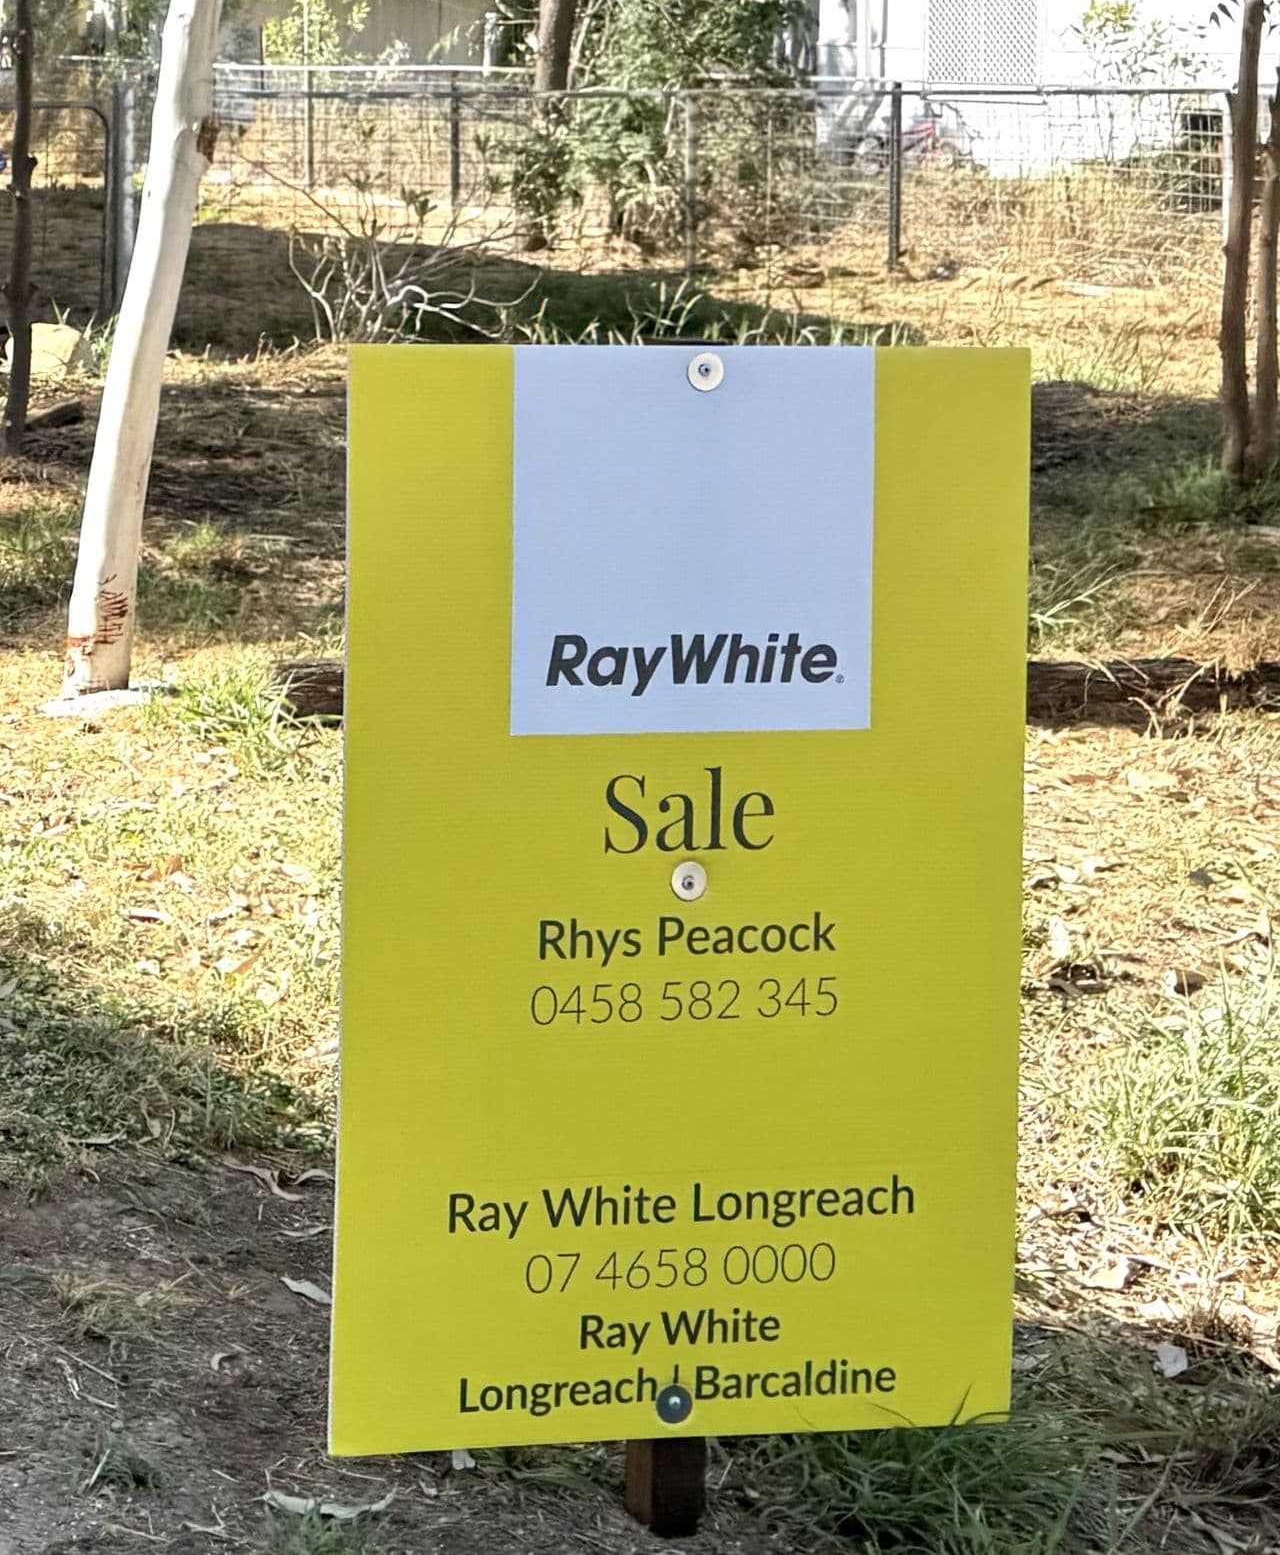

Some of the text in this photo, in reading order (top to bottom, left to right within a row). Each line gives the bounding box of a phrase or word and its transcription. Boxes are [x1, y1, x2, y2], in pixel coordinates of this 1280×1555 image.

[603, 766, 775, 855] Sale
[538, 910, 837, 968] Rhys Peacock
[529, 976, 839, 1026] 0458 582 345
[447, 1173, 915, 1240] Ray White Longreach
[525, 1242, 837, 1295] 07 4658 0000
[579, 1307, 782, 1356] Ray White
[458, 1357, 897, 1418] Longreach Barcaldine
